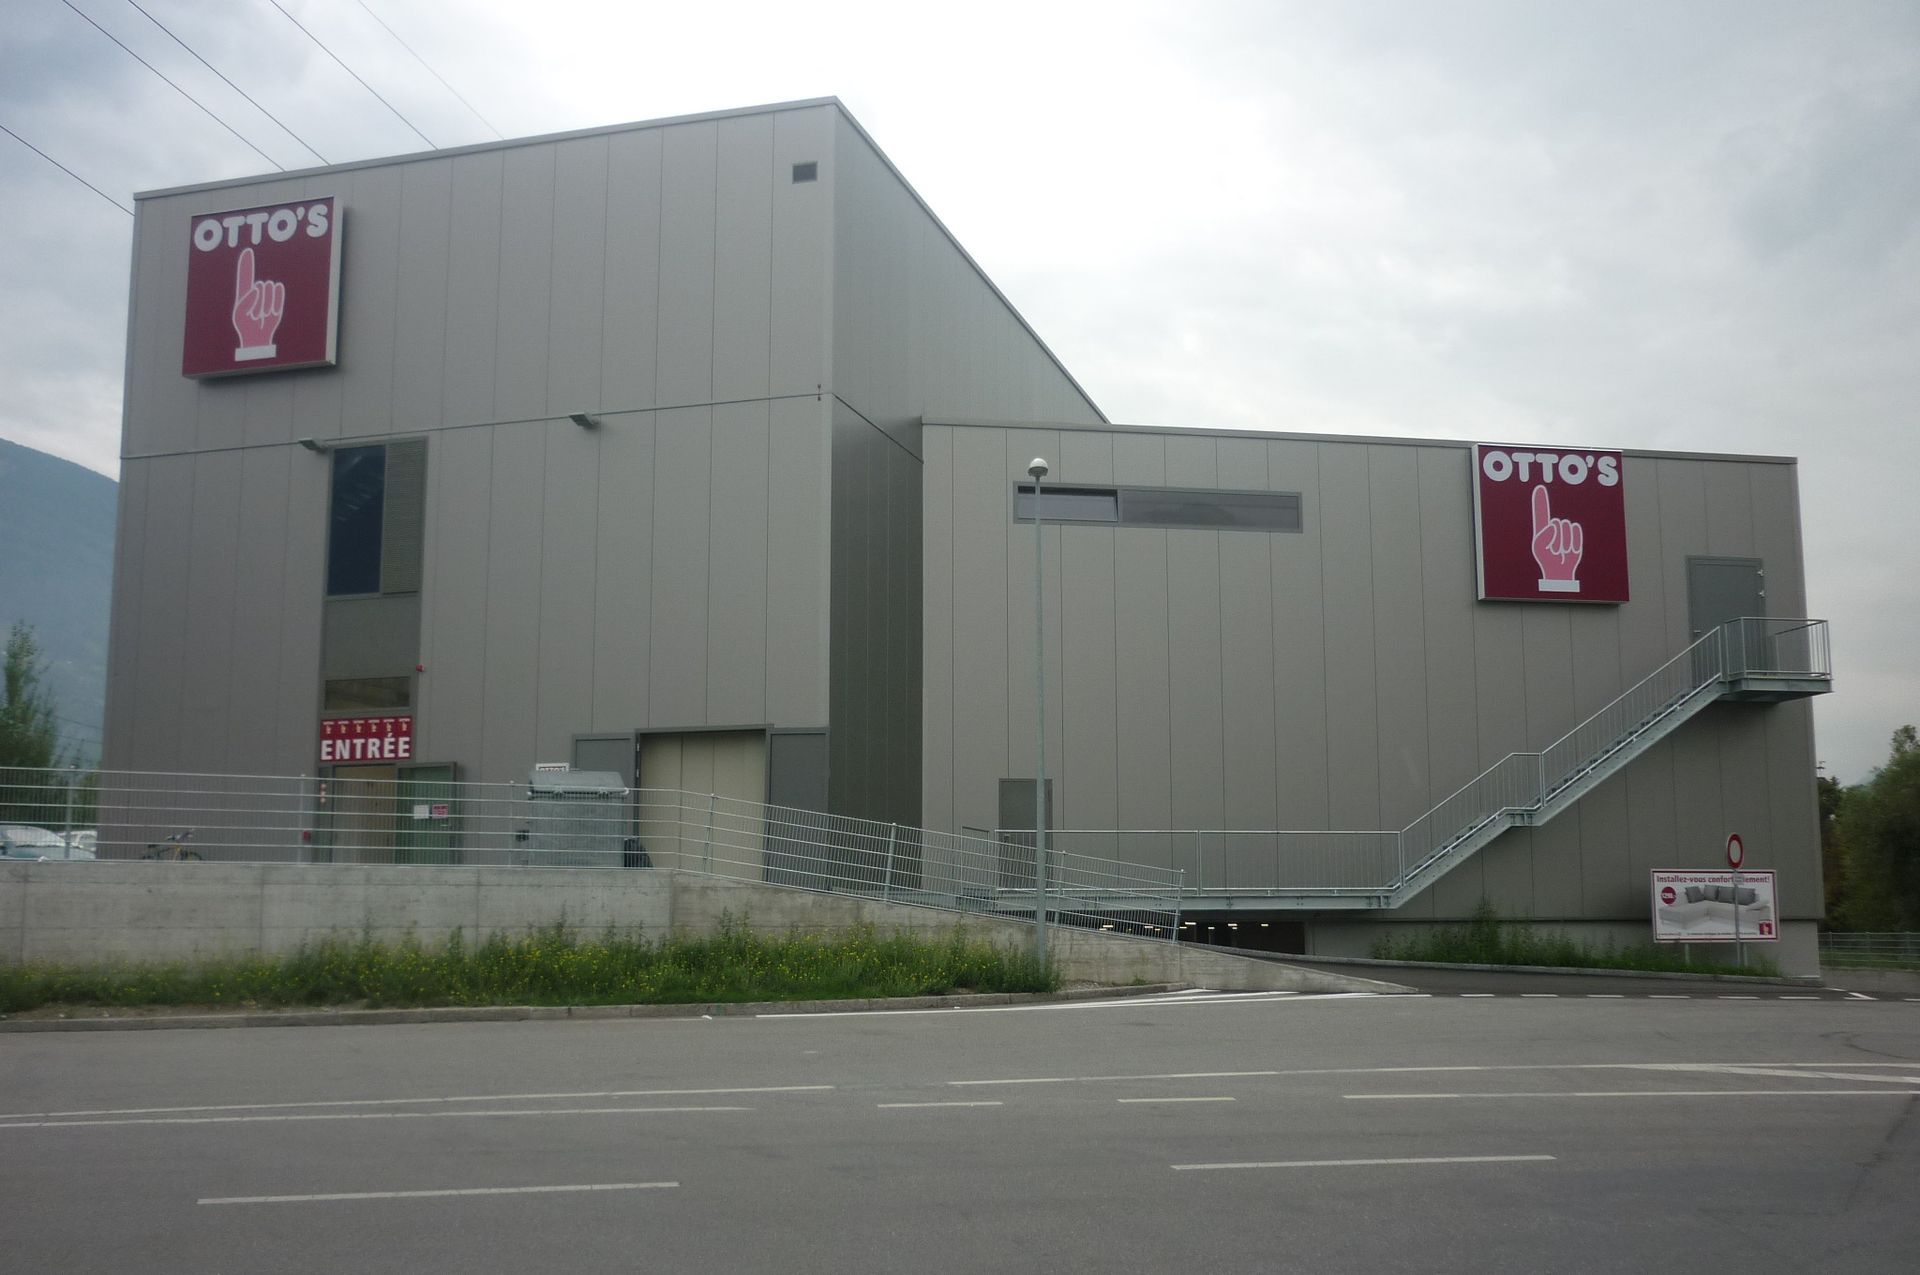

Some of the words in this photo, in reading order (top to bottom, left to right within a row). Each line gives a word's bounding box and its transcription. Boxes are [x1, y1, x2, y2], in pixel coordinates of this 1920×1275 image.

[194, 204, 328, 252] OTTO'S
[1483, 451, 1619, 487] OTTO'S
[321, 732, 410, 761] ENTRÉE
[1657, 875, 1706, 883] Installez-vous
